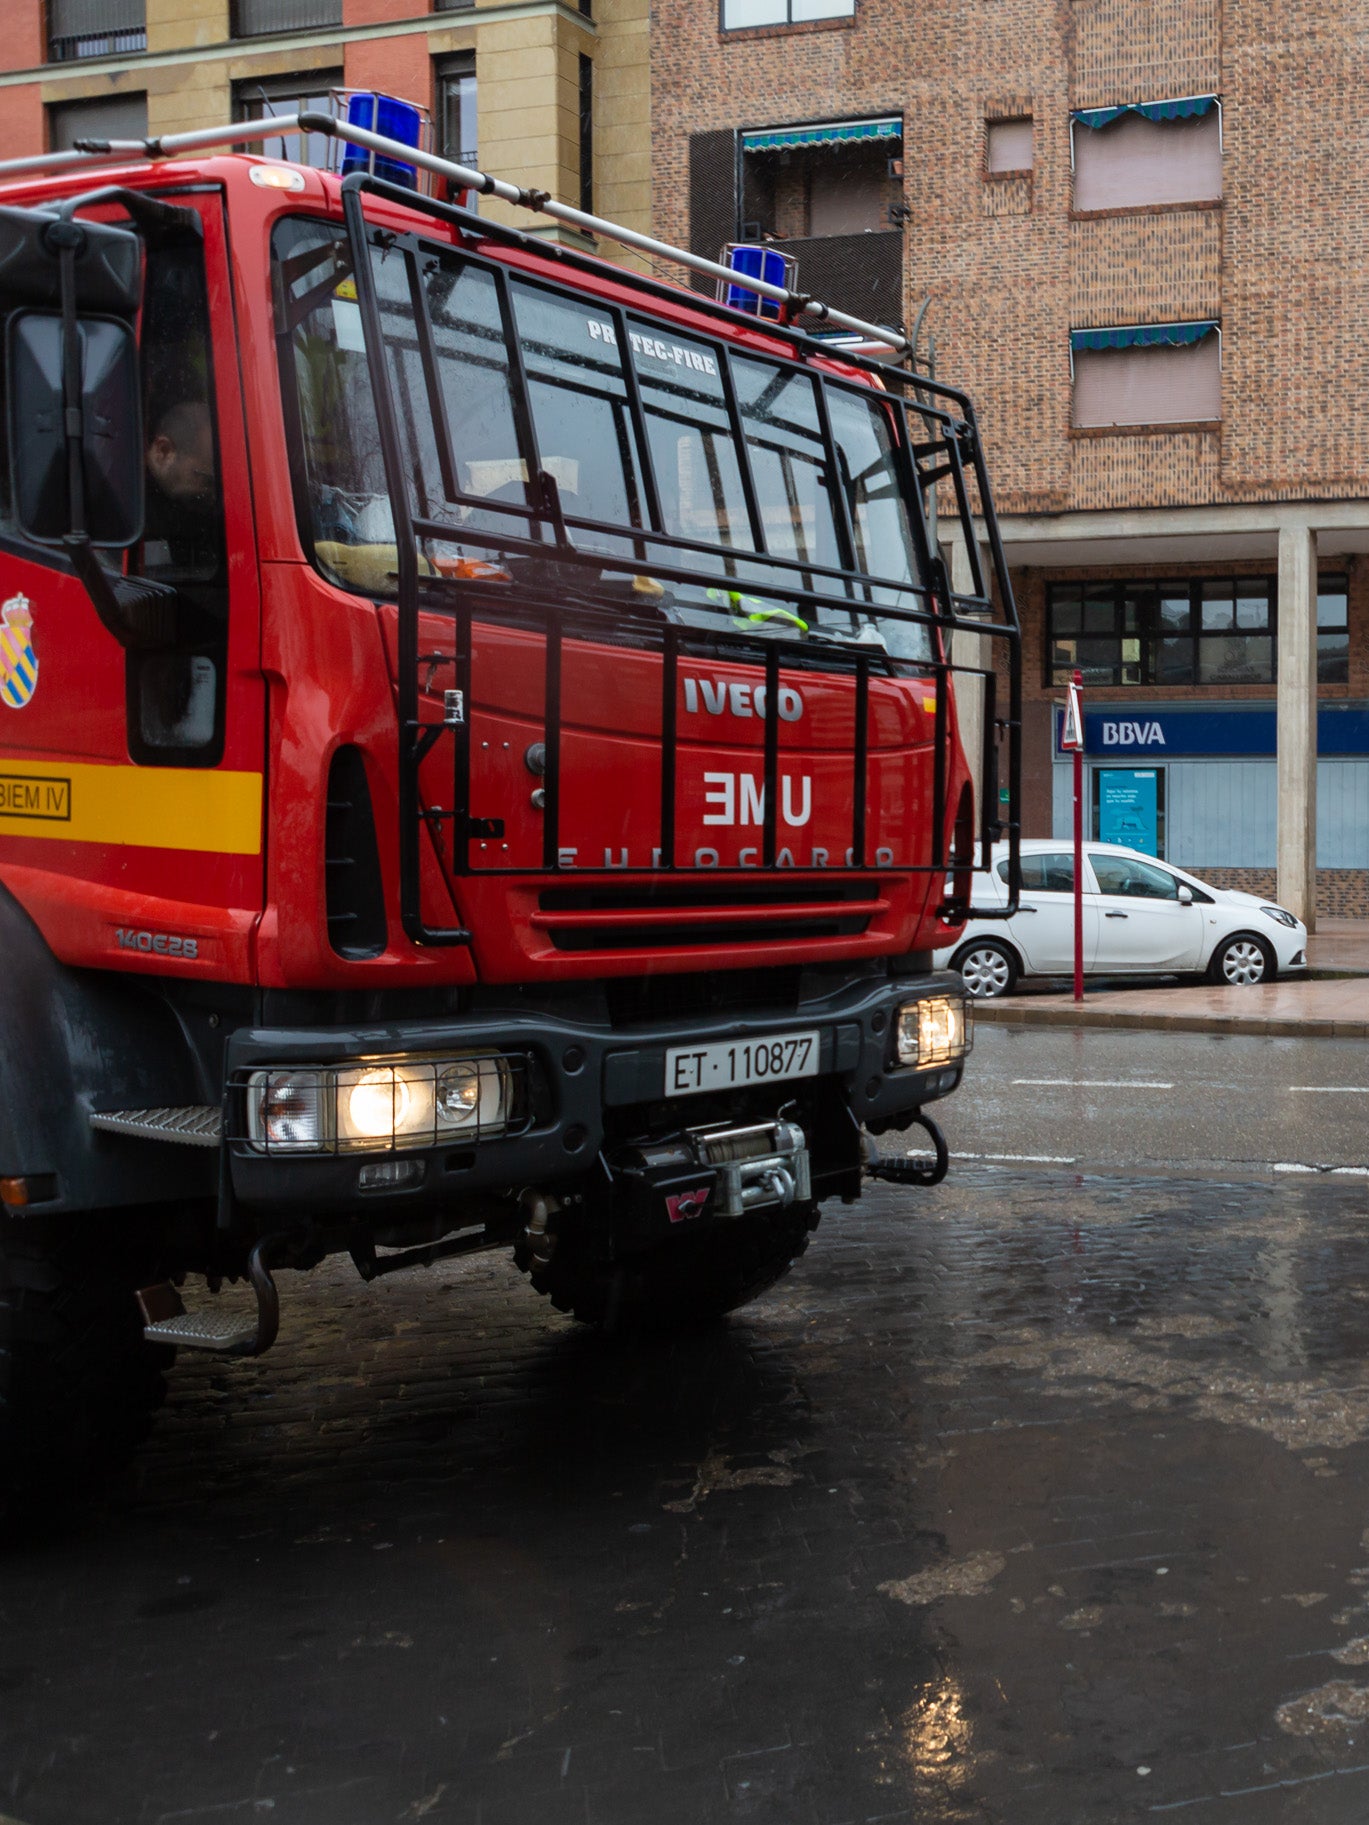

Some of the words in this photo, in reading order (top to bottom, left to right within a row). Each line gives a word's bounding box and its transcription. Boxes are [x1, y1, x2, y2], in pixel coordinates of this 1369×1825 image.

[587, 319, 717, 376] PRTEC-FIRE
[1103, 722, 1166, 745] BBVA
[46, 787, 65, 811] IV
[115, 928, 198, 959] 140E28
